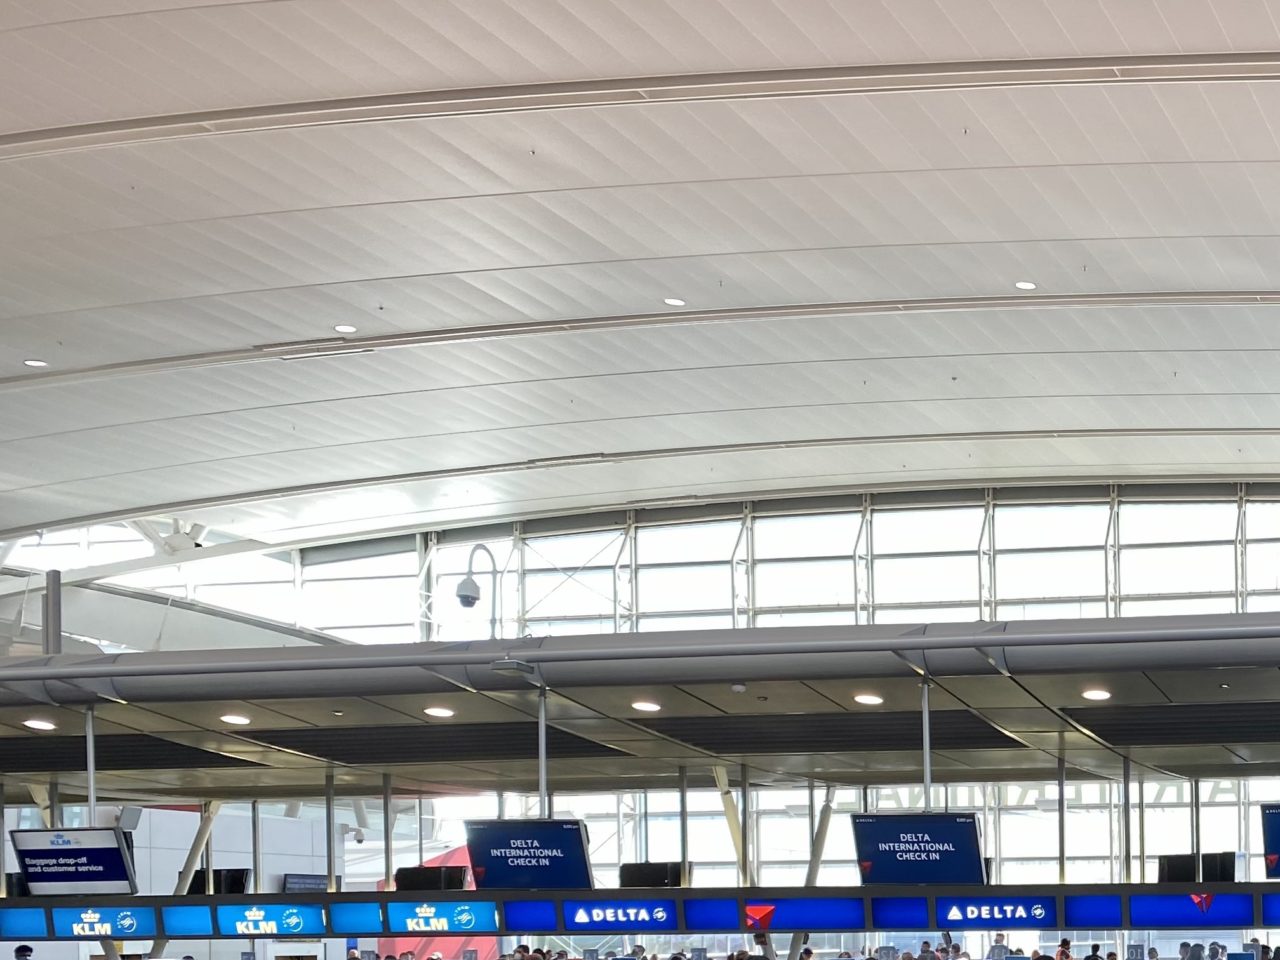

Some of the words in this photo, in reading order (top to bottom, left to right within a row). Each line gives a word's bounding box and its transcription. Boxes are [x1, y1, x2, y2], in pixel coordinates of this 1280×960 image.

[510, 840, 540, 848] DELTA
[879, 843, 955, 851] INTERNATIONAL
[490, 849, 564, 857] INTERNATIONAL
[896, 852, 928, 860] CHECK
[930, 852, 940, 860] IN
[58, 856, 88, 865] drop-off
[508, 858, 538, 866] CHECK
[539, 858, 550, 866] IN
[592, 908, 650, 921] DELTA
[967, 905, 1027, 919] DELTA
[235, 920, 278, 934] KLM
[405, 917, 448, 931] KLM
[72, 922, 112, 936] KLM
